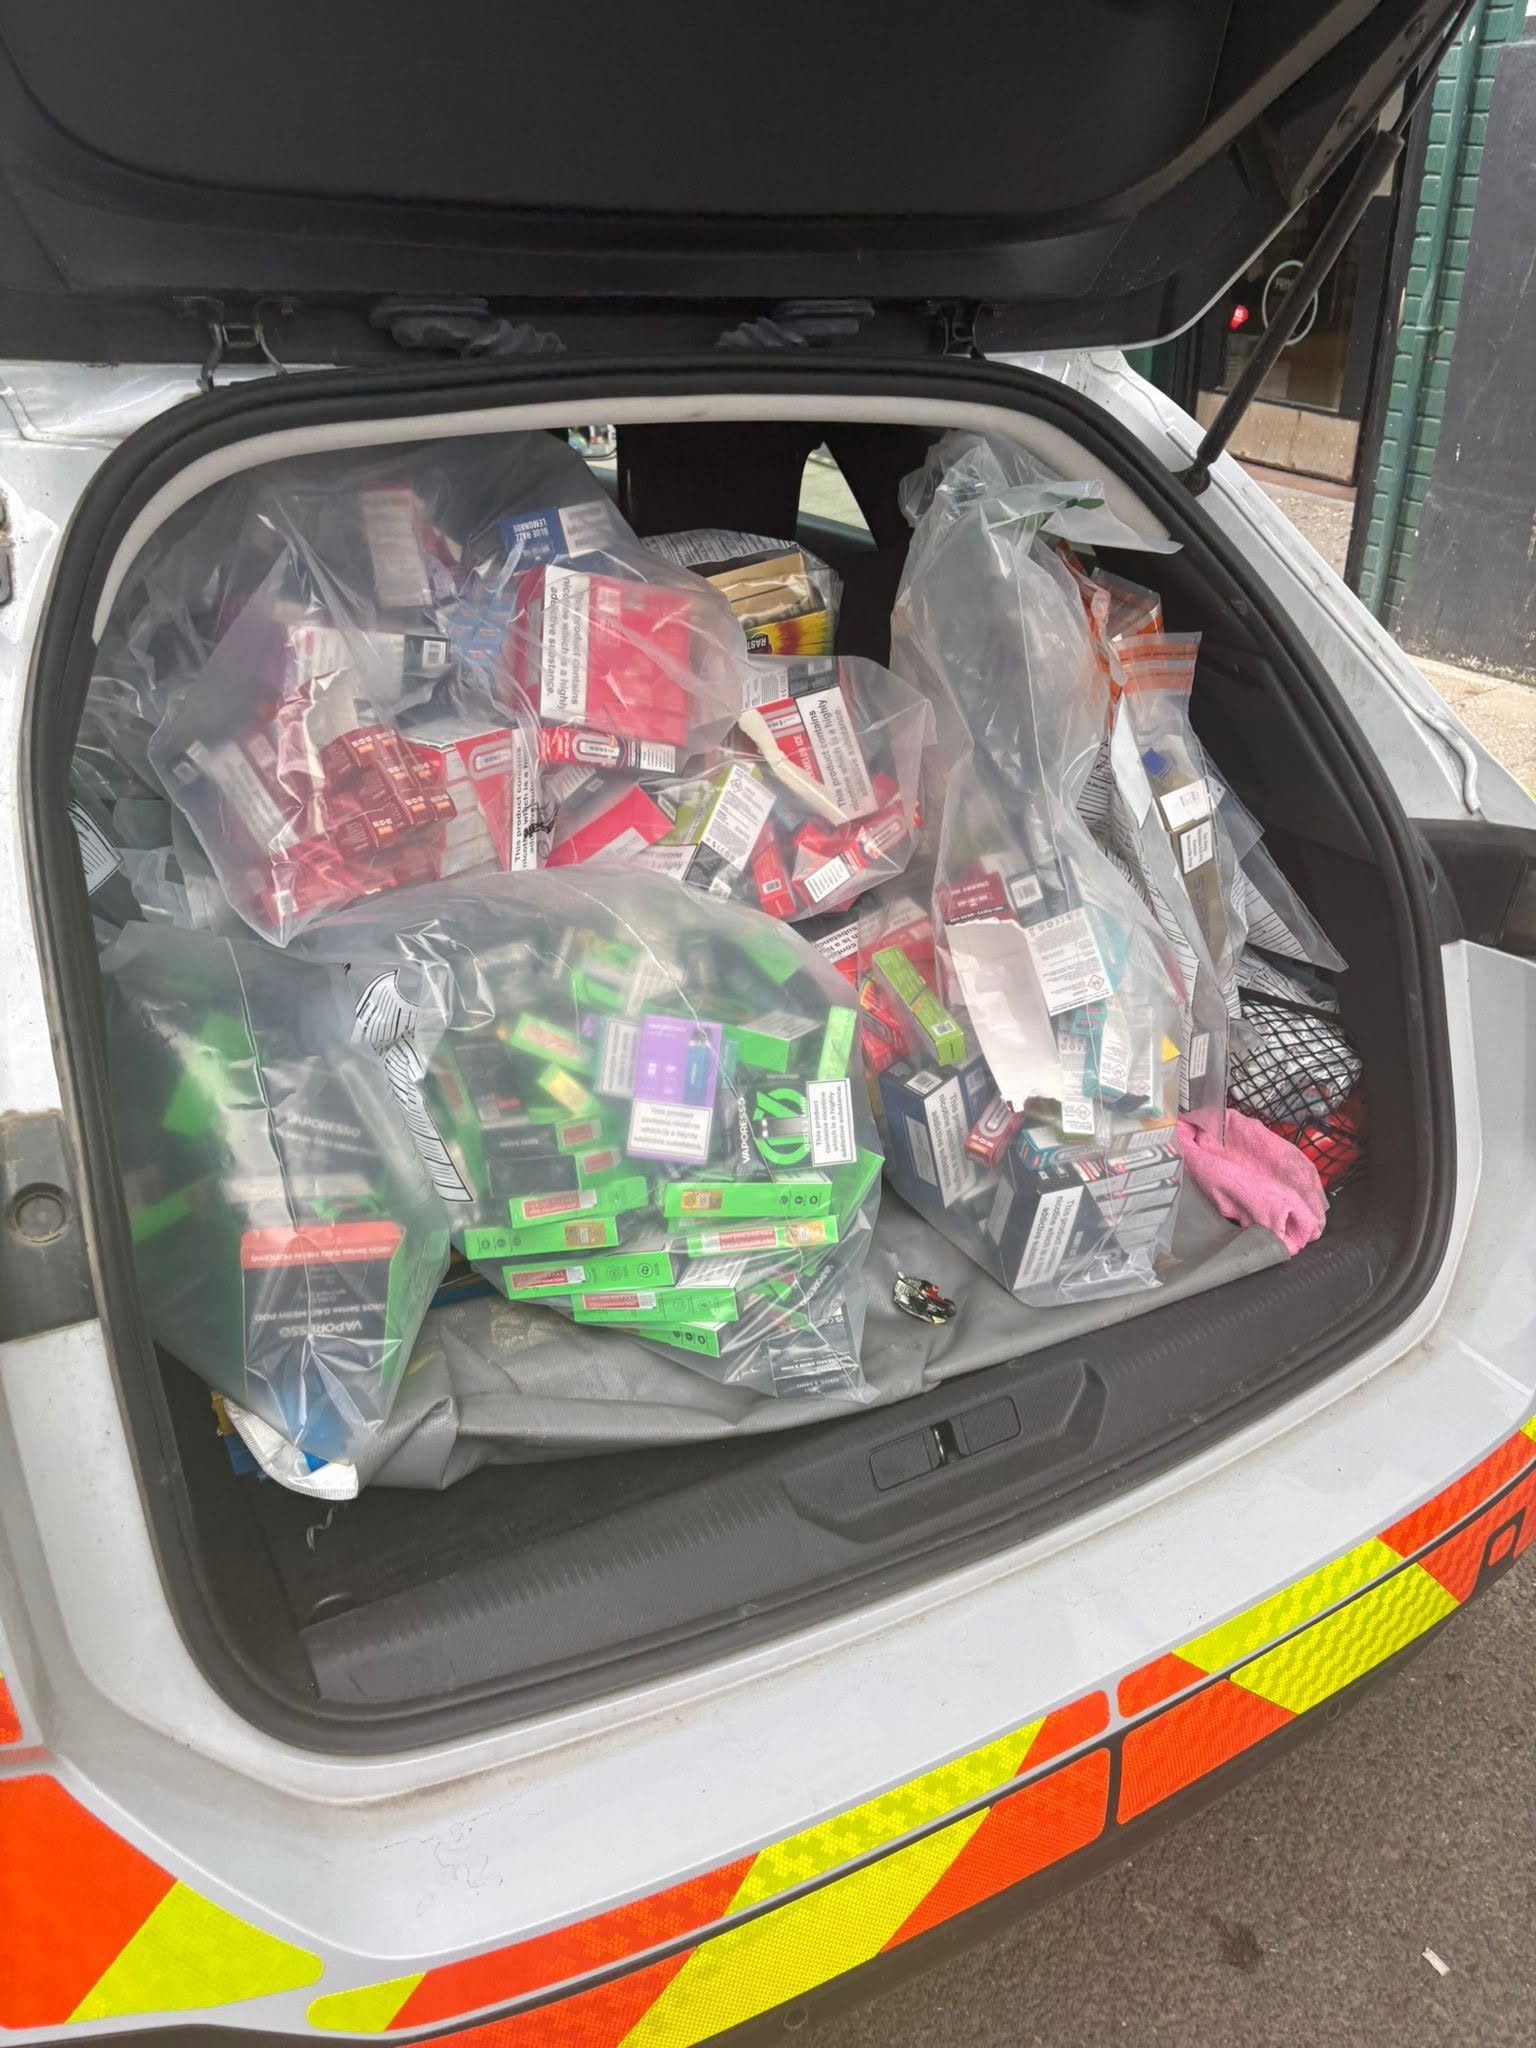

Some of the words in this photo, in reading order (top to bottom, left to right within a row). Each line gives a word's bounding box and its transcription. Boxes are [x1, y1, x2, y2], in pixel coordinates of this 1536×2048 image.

[512, 517, 547, 533] LEMONADE
[532, 527, 549, 538] BLUE
[560, 623, 570, 654] which
[556, 679, 568, 709] highly
[570, 659, 581, 704] contains
[815, 697, 834, 728] highly
[806, 709, 827, 749] contains
[820, 749, 842, 787] product
[833, 787, 847, 808] This
[514, 795, 523, 837] product
[812, 1100, 821, 1128] product
[819, 1091, 827, 1120] nicotine
[827, 1091, 836, 1114] highly
[835, 1085, 844, 1123] substance.
[938, 1093, 950, 1127] nicotine
[948, 1093, 959, 1113] This
[737, 1096, 750, 1164] VAPORESSO
[822, 1122, 830, 1153] contains
[931, 1110, 944, 1147] addictive
[1048, 1194, 1064, 1226] nicotine
[1062, 1198, 1074, 1217] This
[1033, 1206, 1050, 1241] addictive
[278, 1319, 362, 1337] VAPORESSO
